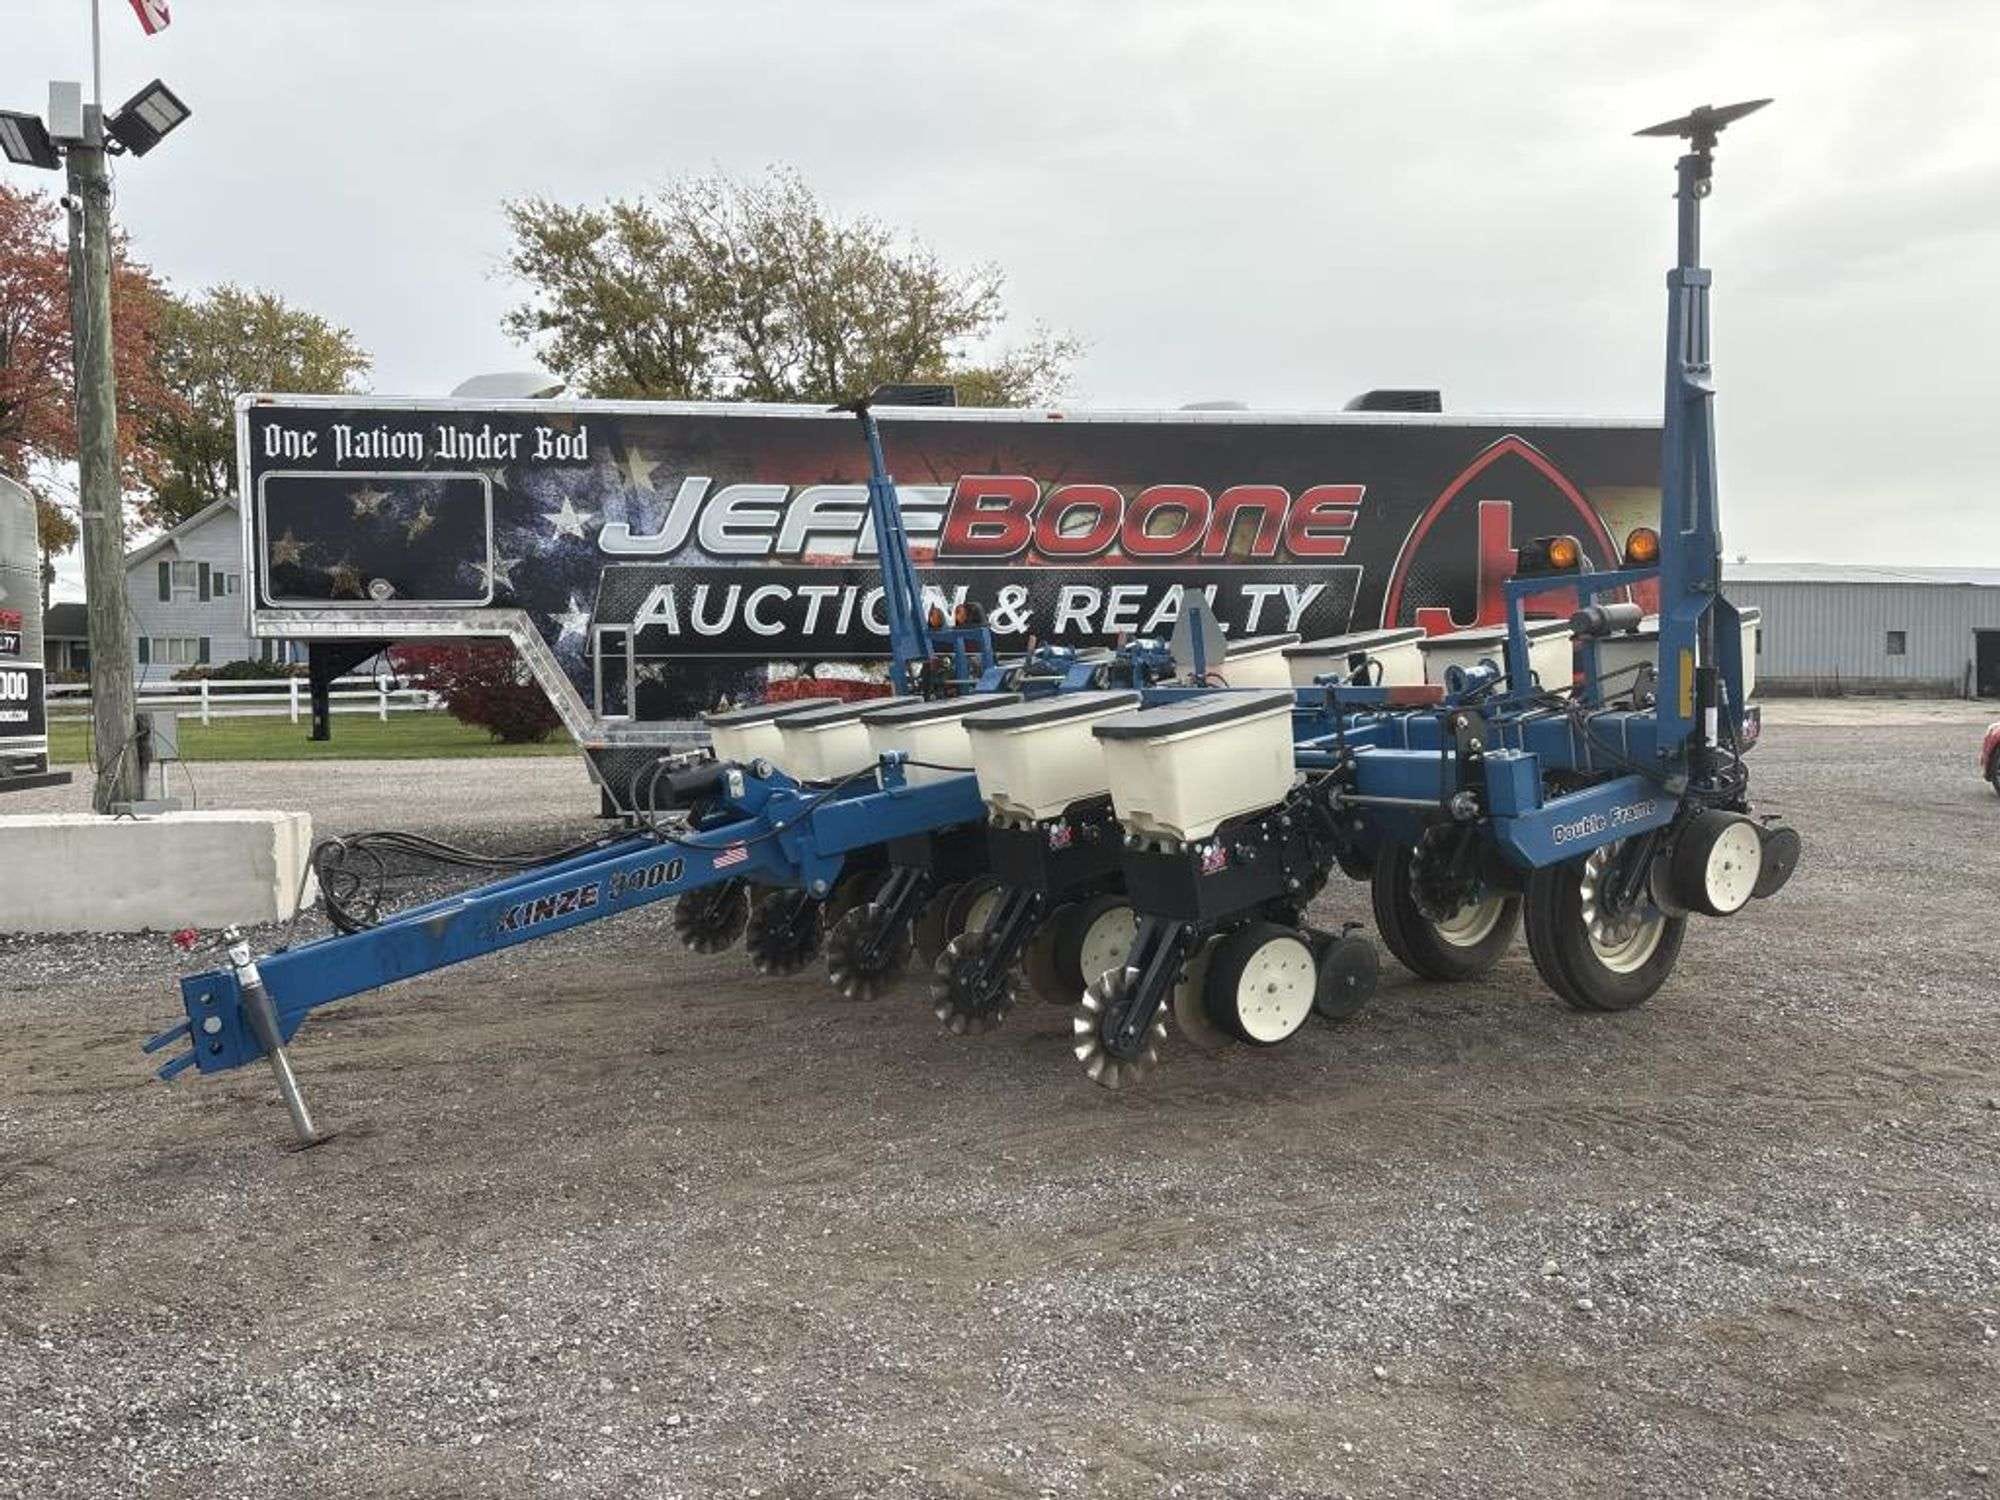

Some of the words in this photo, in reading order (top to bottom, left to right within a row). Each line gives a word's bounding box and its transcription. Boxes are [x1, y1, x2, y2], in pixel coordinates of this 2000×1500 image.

[263, 424, 318, 460] One
[331, 423, 424, 468] Nation
[434, 425, 523, 462] Under
[987, 583, 1035, 635] &
[1552, 813, 1608, 845] Double
[1609, 798, 1657, 827] Frame
[497, 880, 601, 933] KINZE
